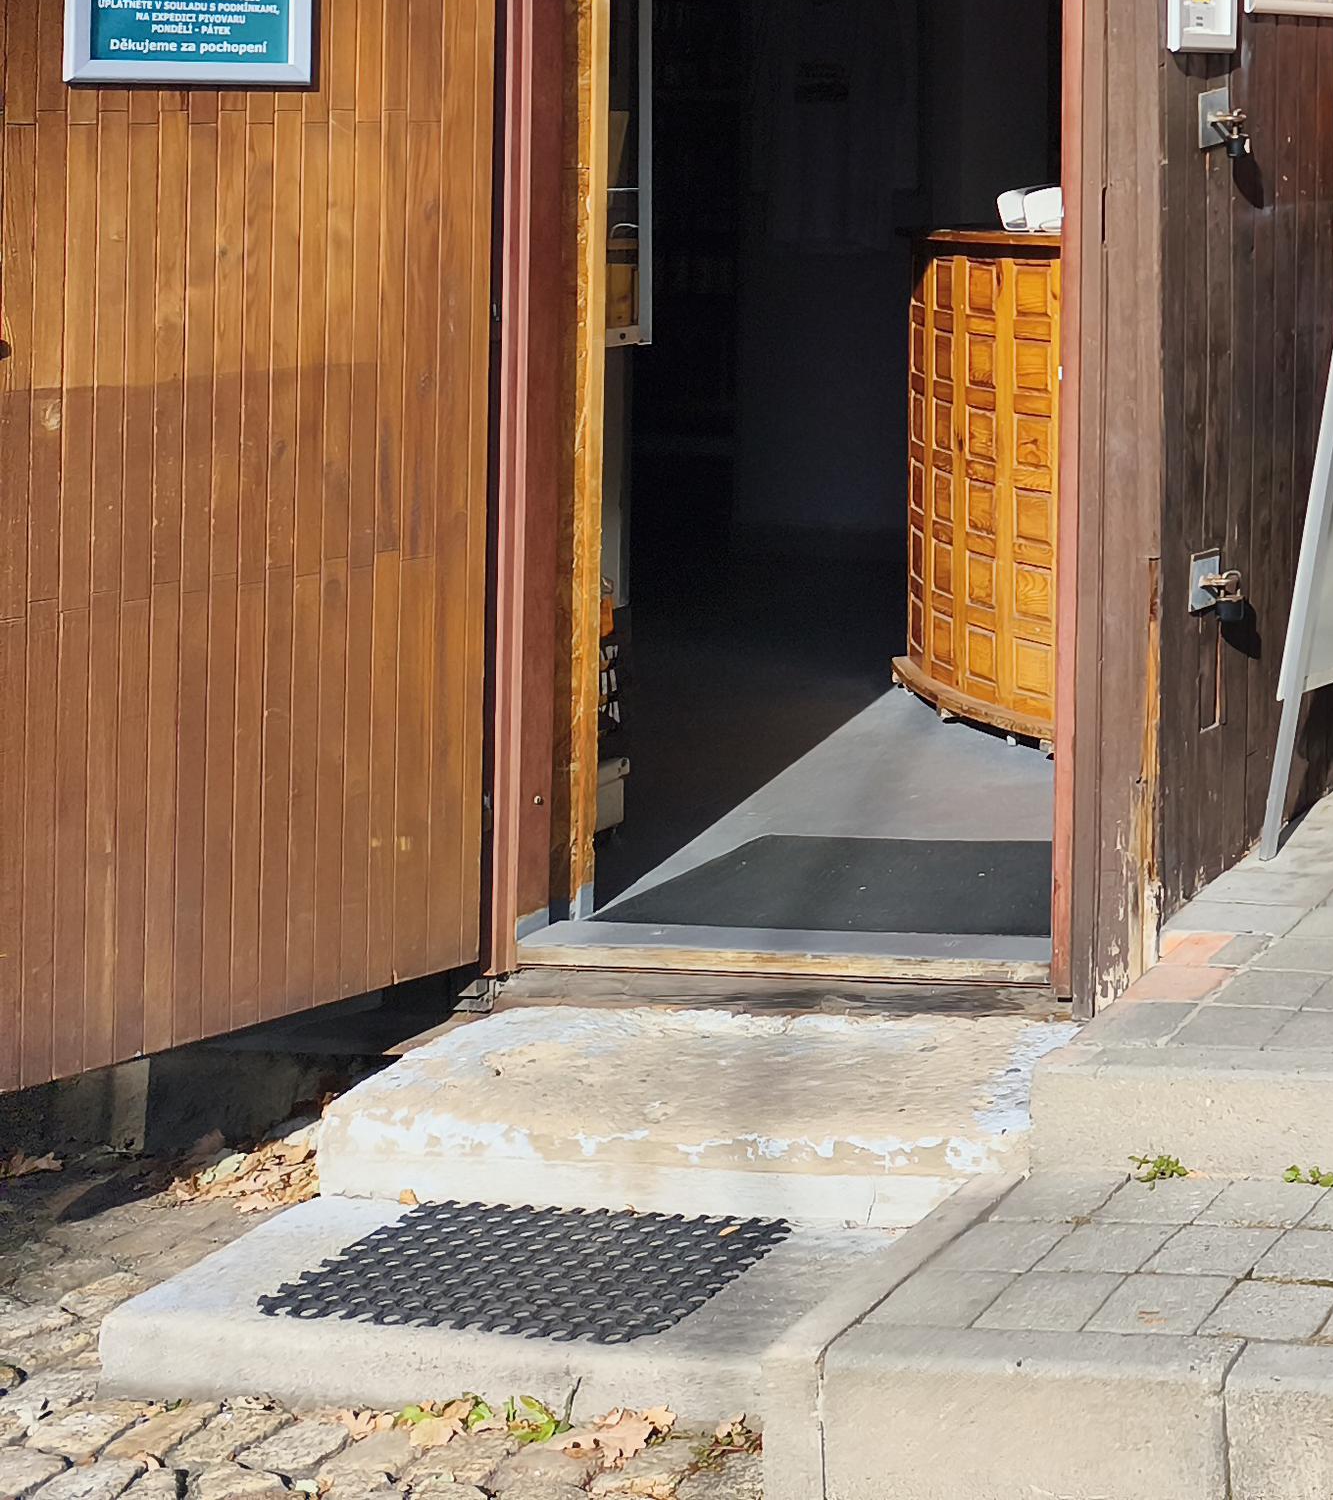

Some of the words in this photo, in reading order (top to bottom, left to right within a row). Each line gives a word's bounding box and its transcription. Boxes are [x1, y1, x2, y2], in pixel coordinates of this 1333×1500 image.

[154, 1, 162, 10] V
[163, 1, 208, 12] SOULADU
[209, 3, 216, 12] S
[109, 38, 178, 53] Děkujeme
[180, 42, 196, 52] za
[200, 40, 268, 56] pochopení
